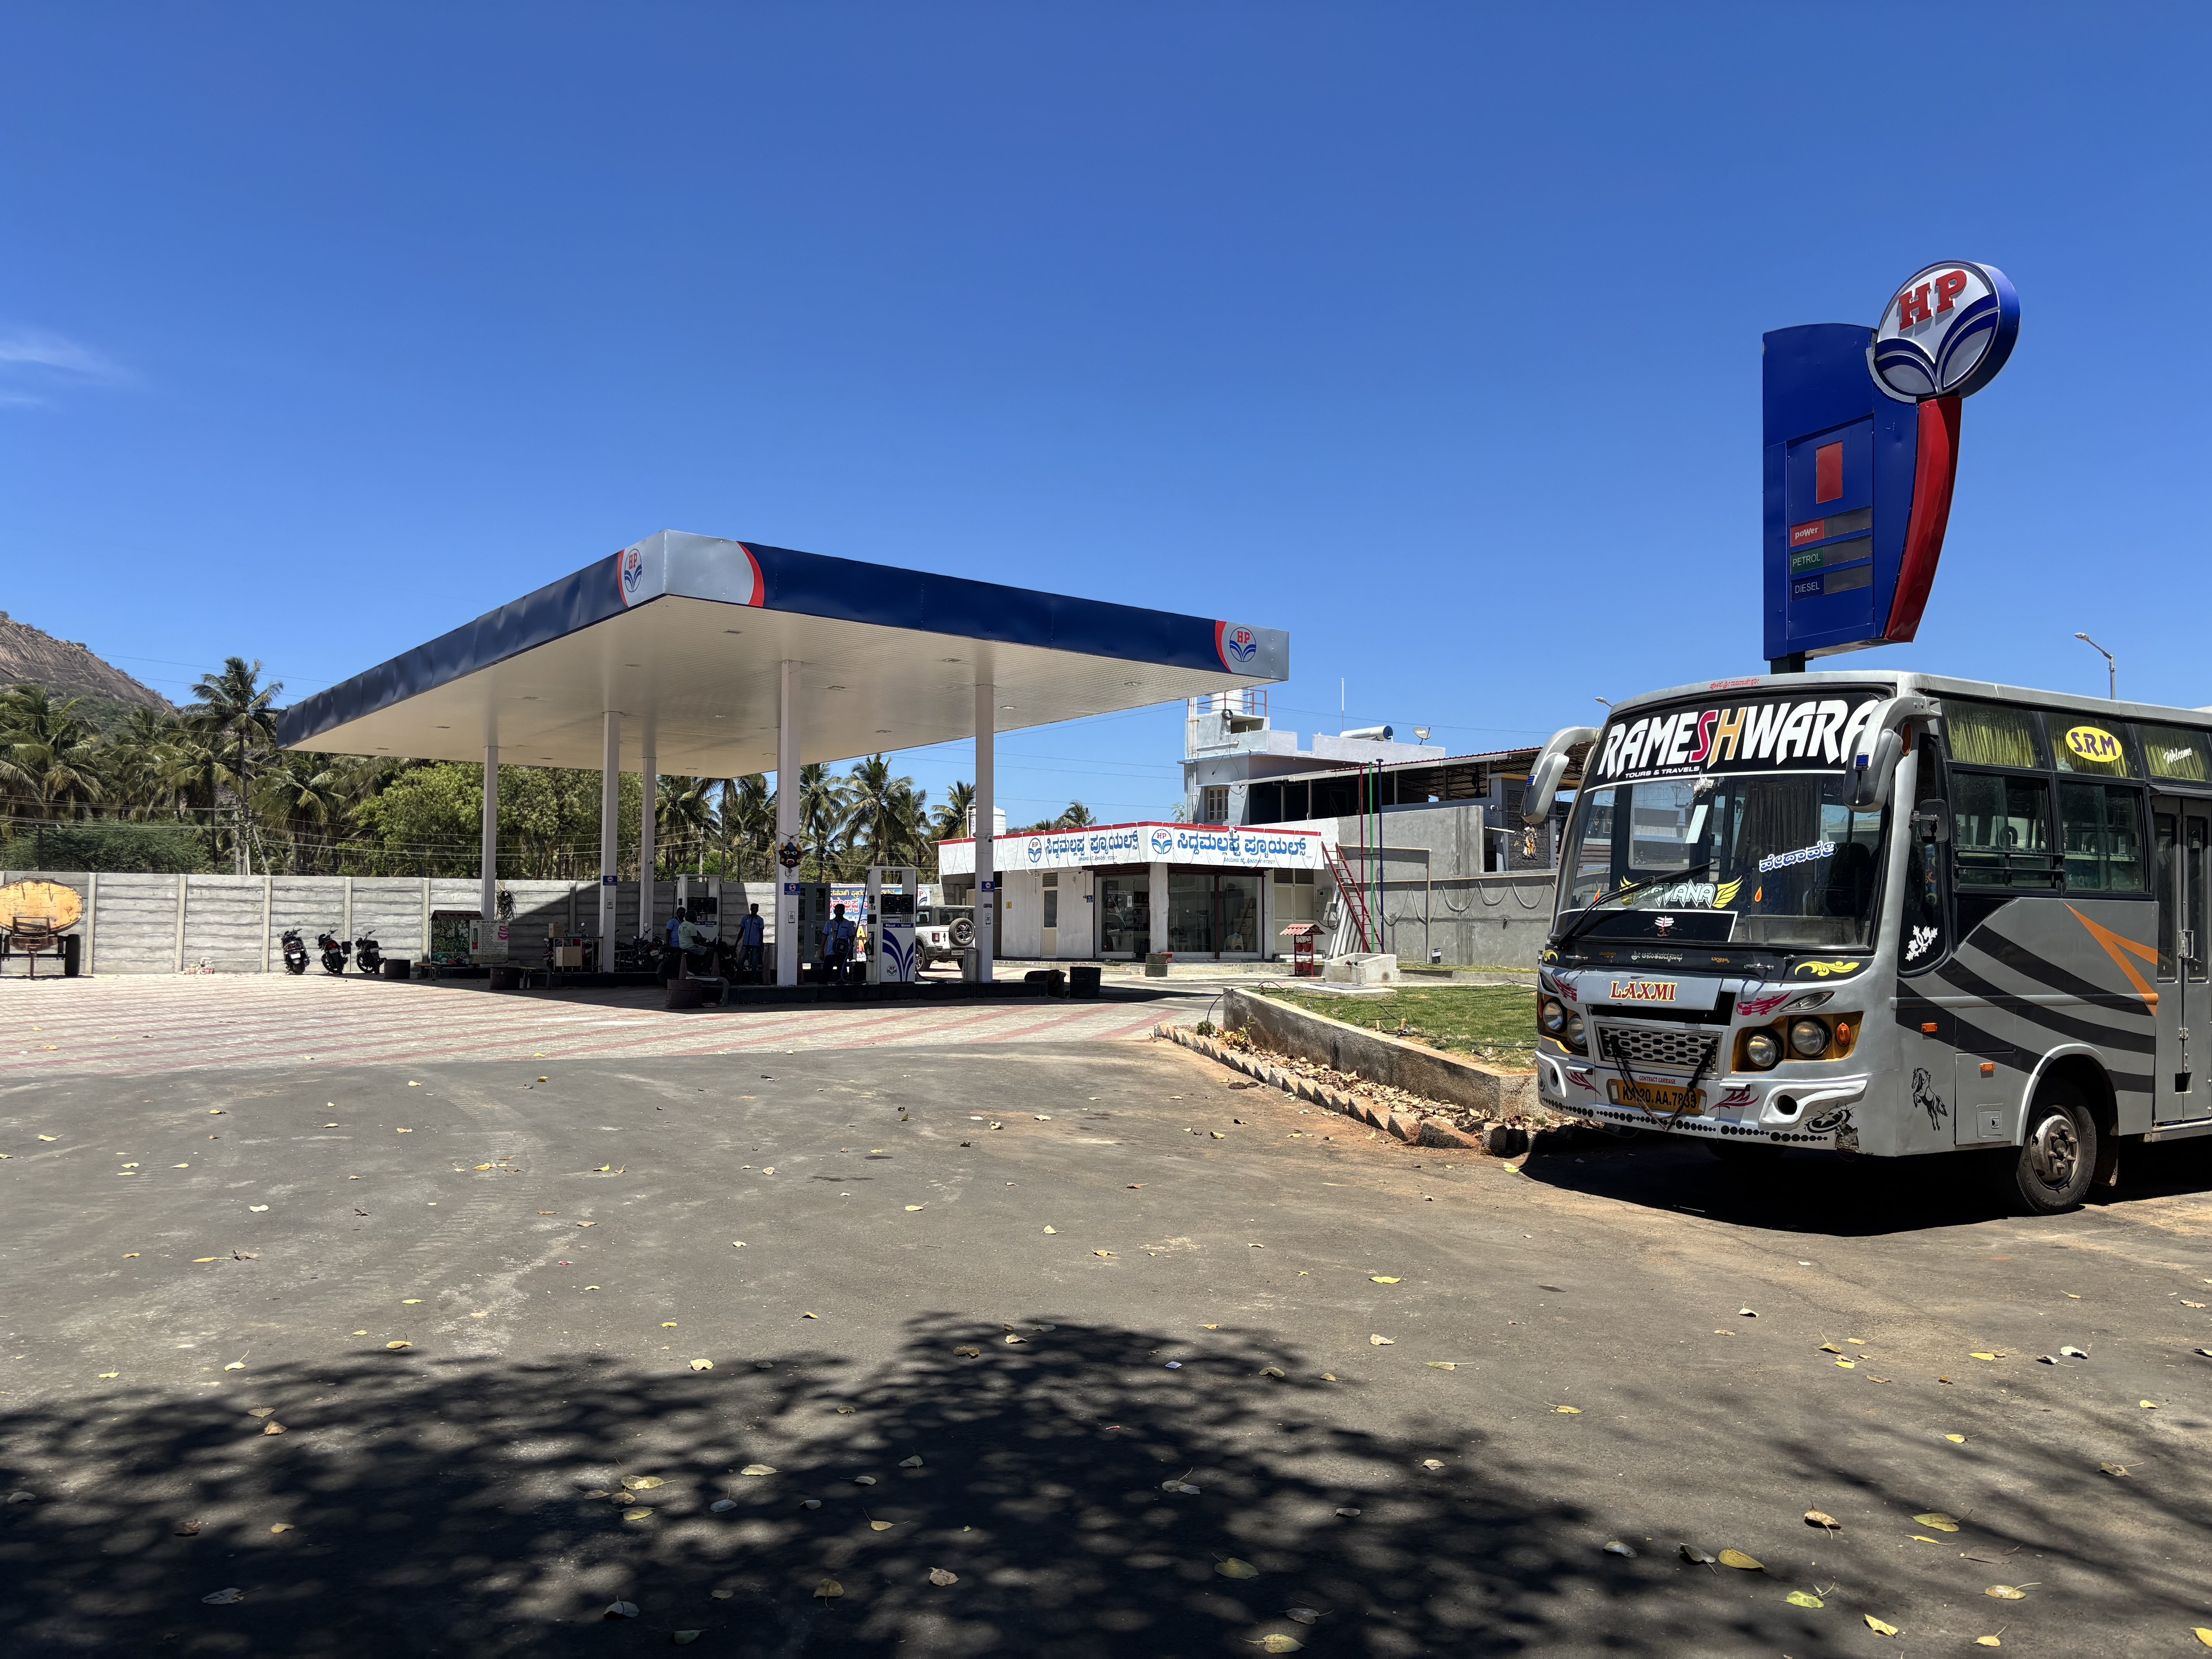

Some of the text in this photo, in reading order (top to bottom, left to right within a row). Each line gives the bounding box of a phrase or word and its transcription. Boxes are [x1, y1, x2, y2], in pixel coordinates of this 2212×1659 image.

[1899, 270, 1967, 331] HP
[628, 552, 638, 570] HP
[1793, 553, 1821, 567] PETROL
[1795, 582, 1820, 594] DIESEL
[1237, 630, 1250, 644] HP
[2163, 747, 2192, 764] Welcome
[1662, 766, 1700, 775] TRAVELS
[1631, 950, 1641, 960] ಶ್ರೀ
[1609, 981, 1678, 1001] LAXMI
